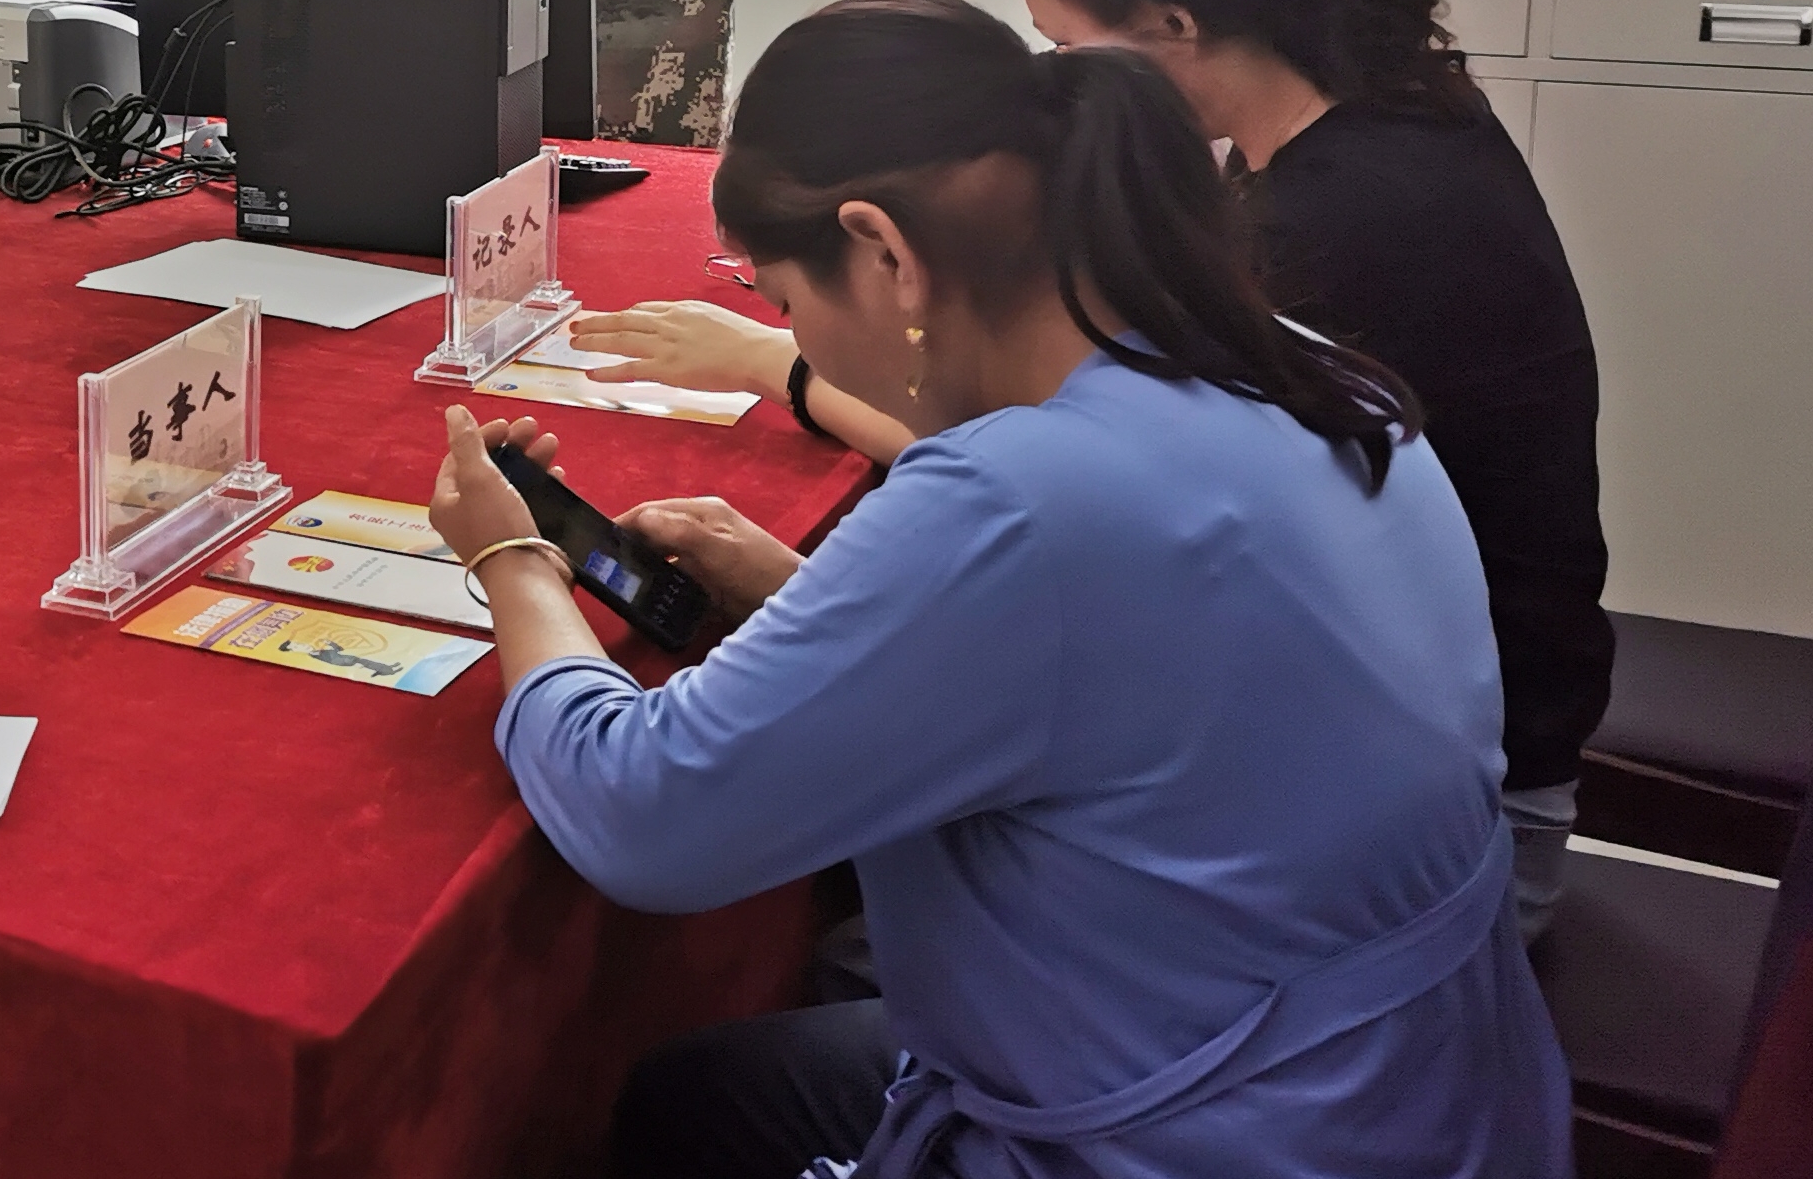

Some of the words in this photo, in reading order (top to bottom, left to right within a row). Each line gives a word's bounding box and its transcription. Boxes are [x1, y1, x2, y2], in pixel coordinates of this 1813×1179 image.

[473, 206, 541, 270] 记录人
[128, 371, 236, 463] 当事人
